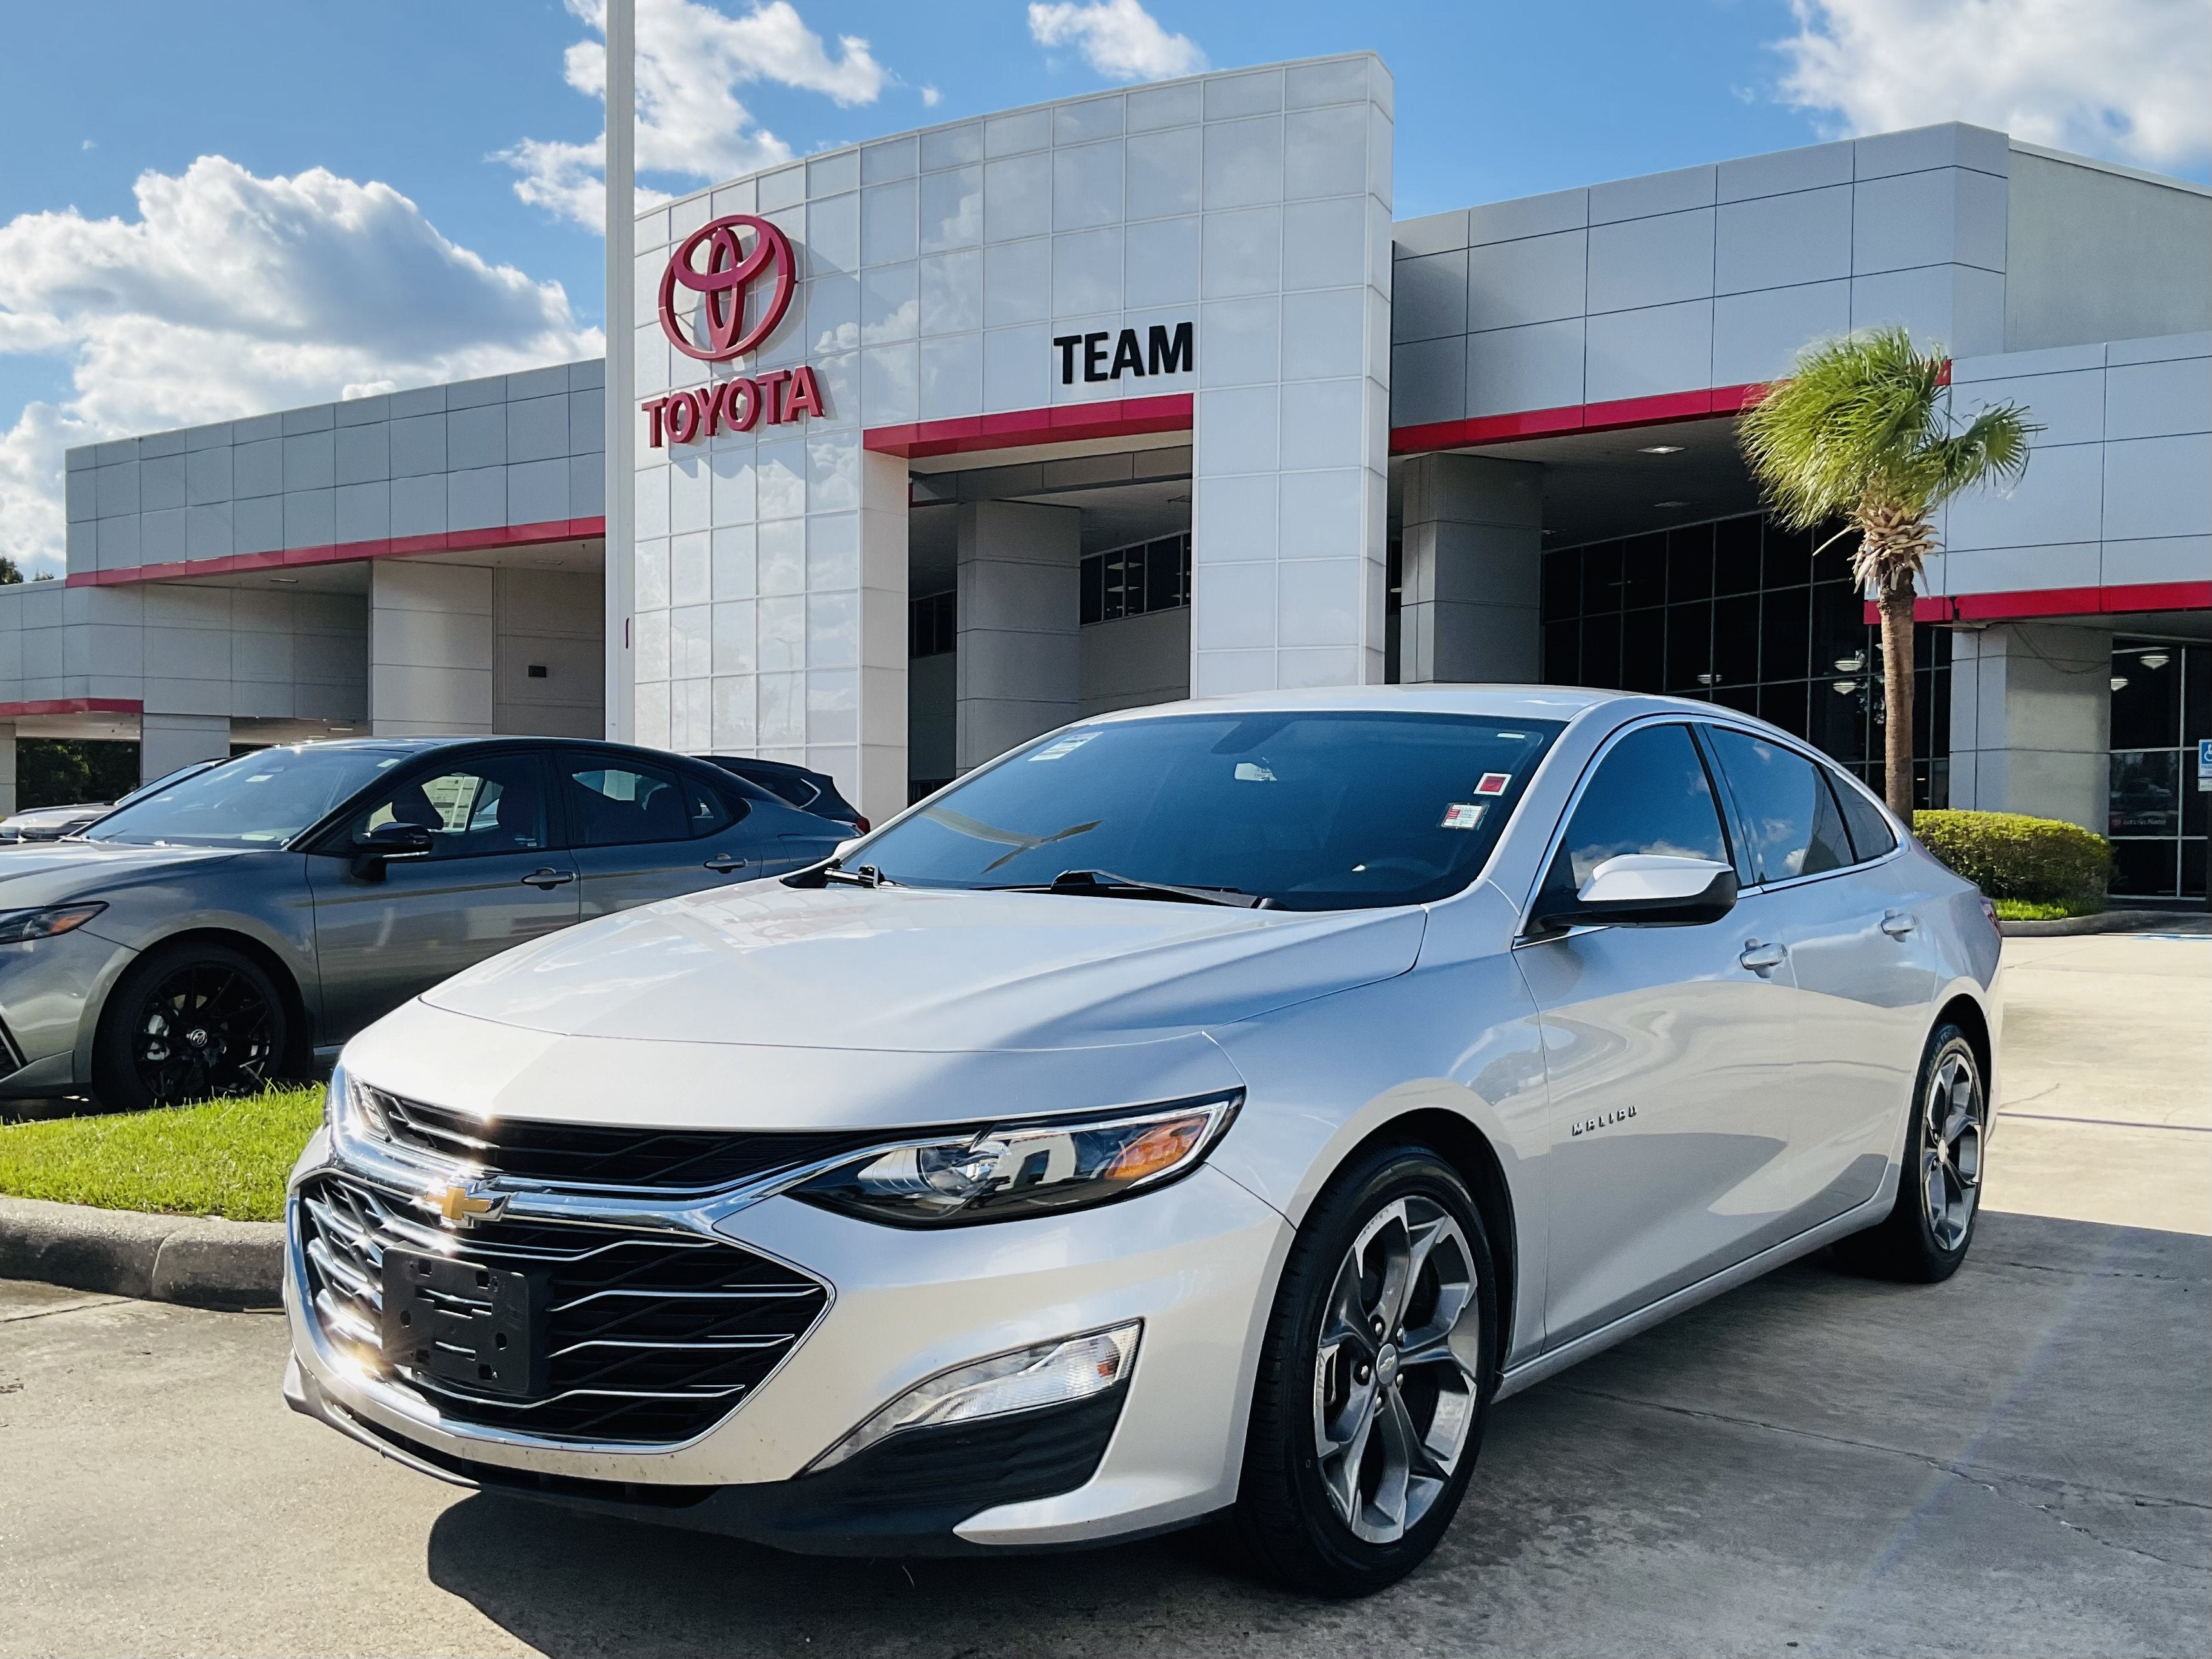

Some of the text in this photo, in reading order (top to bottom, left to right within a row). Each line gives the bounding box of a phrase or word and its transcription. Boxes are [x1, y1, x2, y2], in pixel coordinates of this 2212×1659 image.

[1053, 322, 1193, 385] TEAM
[642, 365, 824, 448] TOYOTA
[1572, 1106, 1637, 1136] MALIBU
